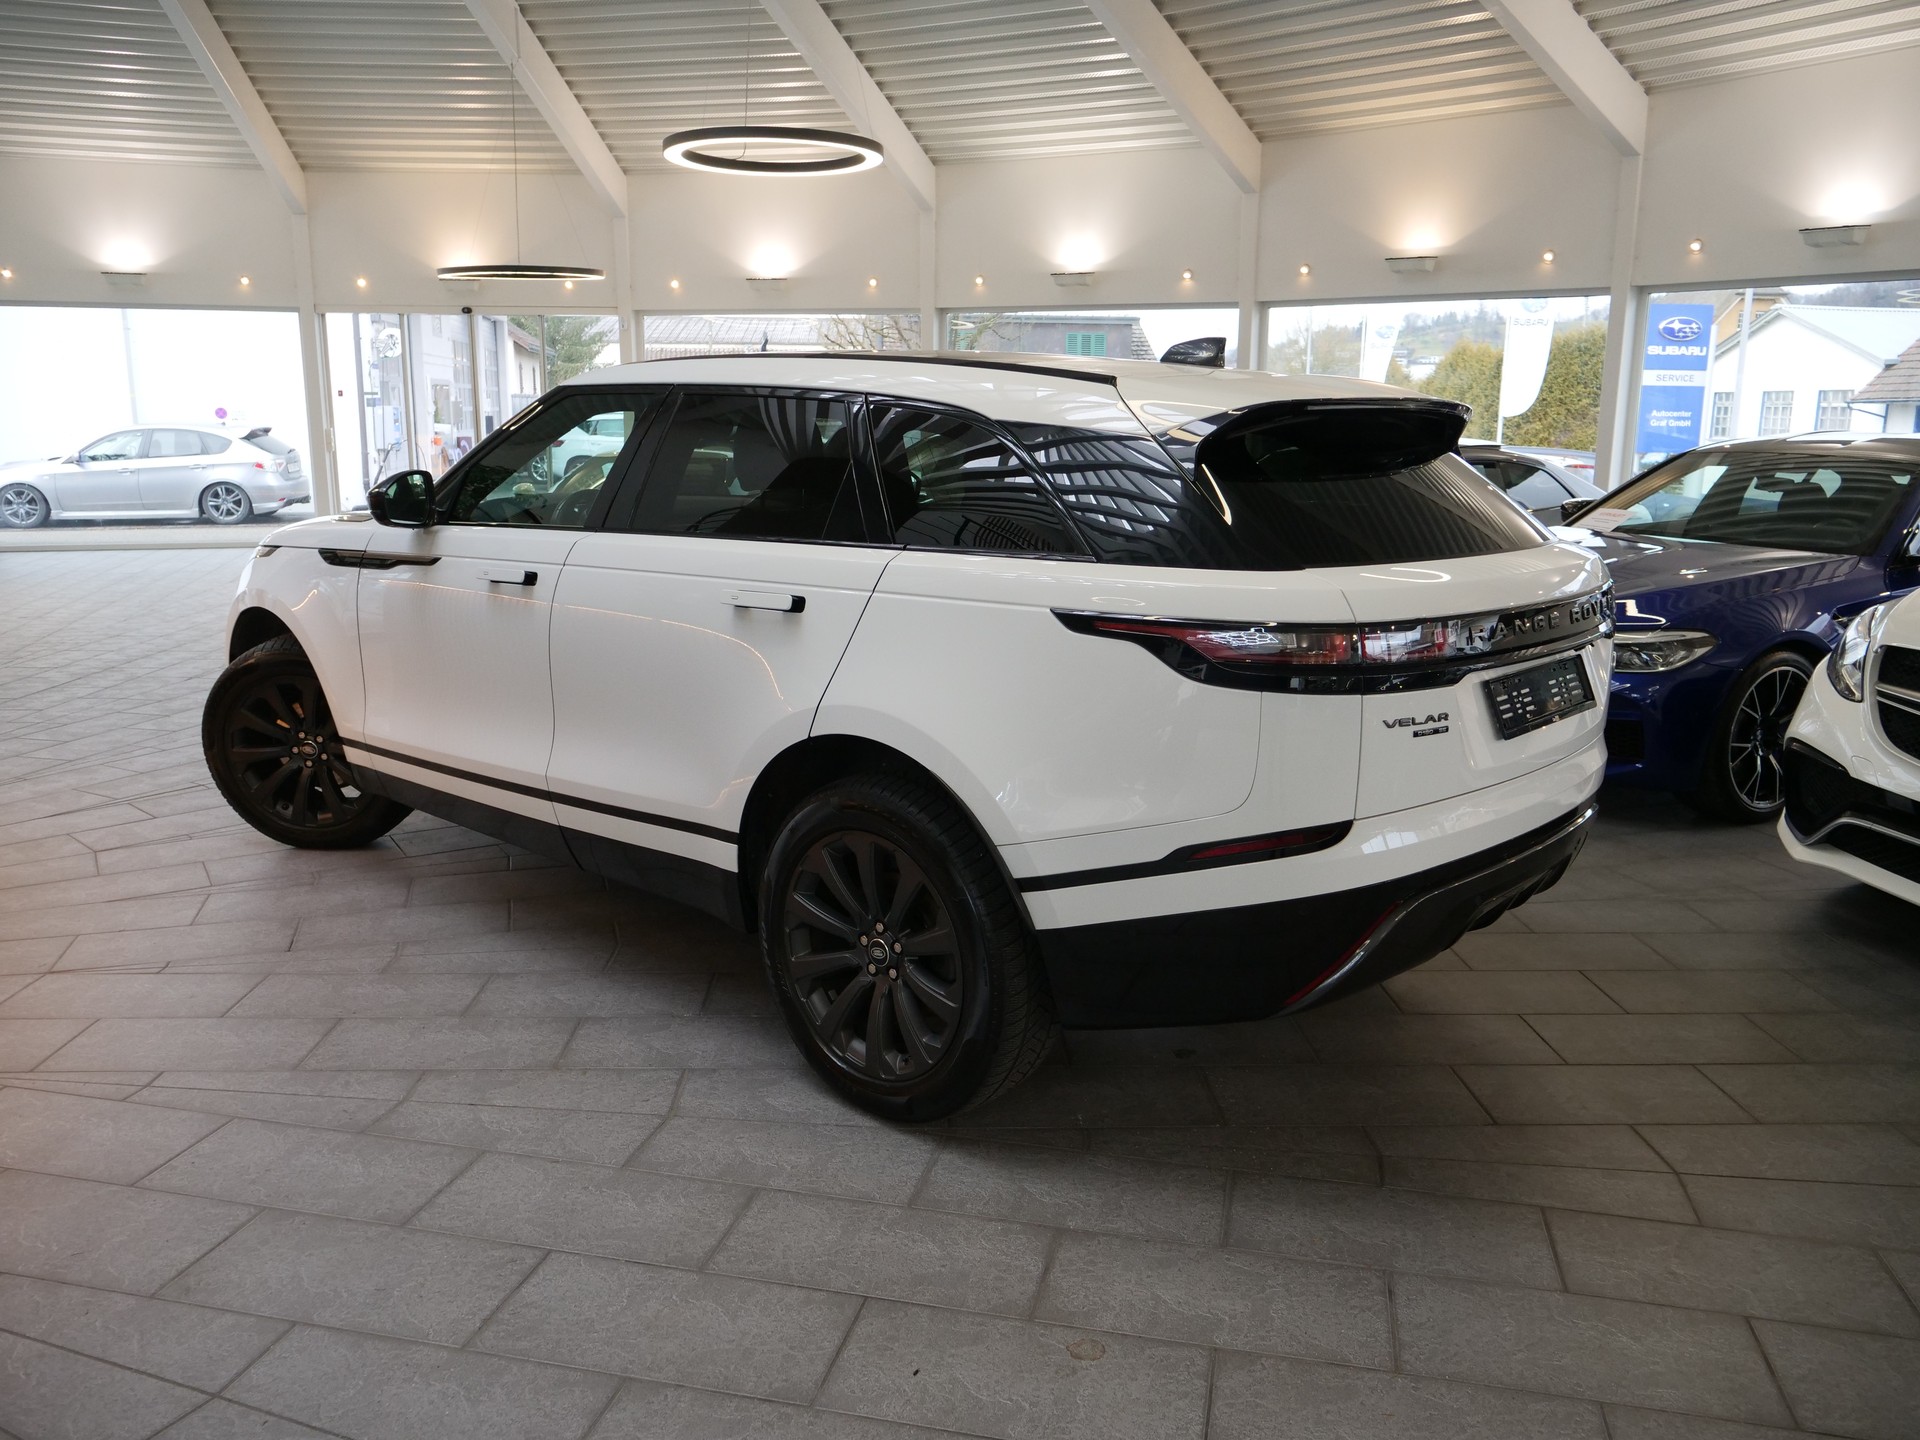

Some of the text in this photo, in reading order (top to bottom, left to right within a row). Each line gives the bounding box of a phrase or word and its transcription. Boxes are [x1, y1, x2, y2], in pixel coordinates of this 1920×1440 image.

[1647, 345, 1707, 356] SUBARU
[1655, 374, 1695, 382] SERVICE
[1651, 409, 1692, 418] Autocenter
[1650, 419, 1692, 427] Graf GmbH
[1467, 610, 1560, 646] RANGE
[1382, 712, 1449, 729] VELAR
